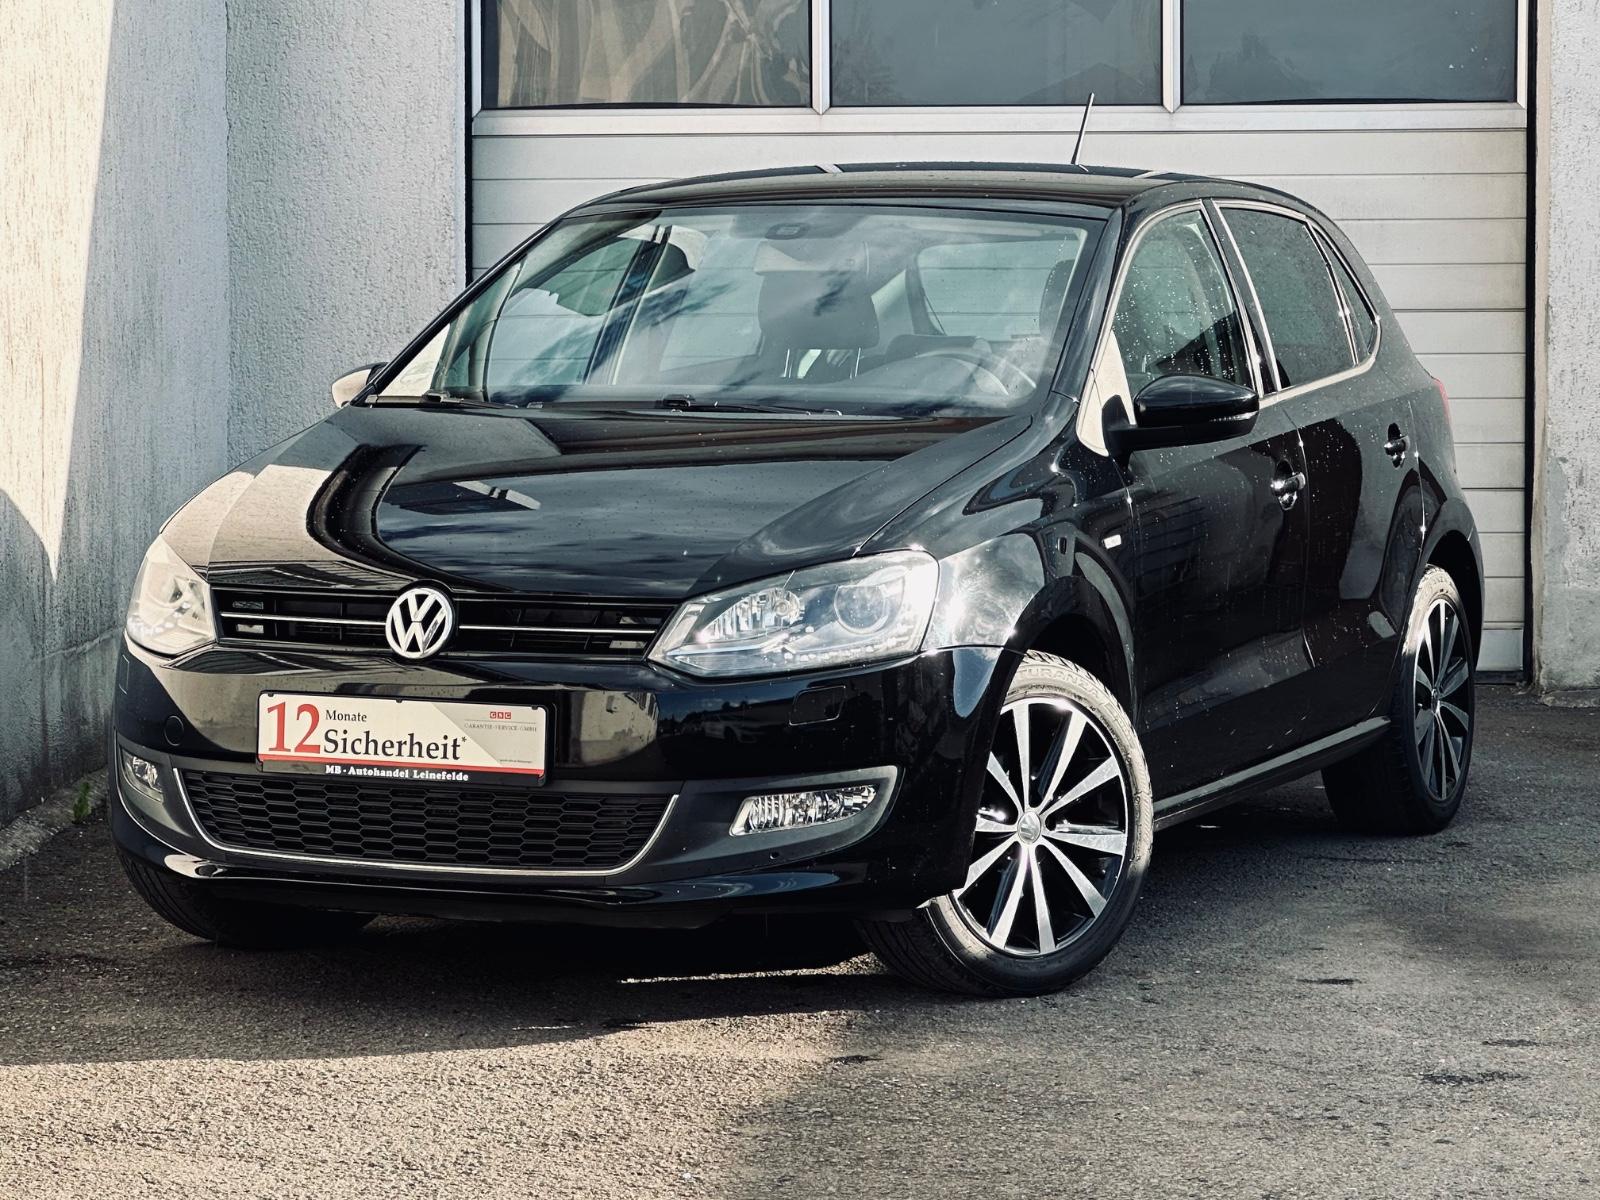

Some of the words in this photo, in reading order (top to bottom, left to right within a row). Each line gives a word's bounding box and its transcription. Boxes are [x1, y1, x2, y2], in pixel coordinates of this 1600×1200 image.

[386, 588, 453, 659] VW
[267, 702, 320, 754] 12
[325, 709, 367, 722] Monate
[413, 770, 469, 781] Leinefelde
